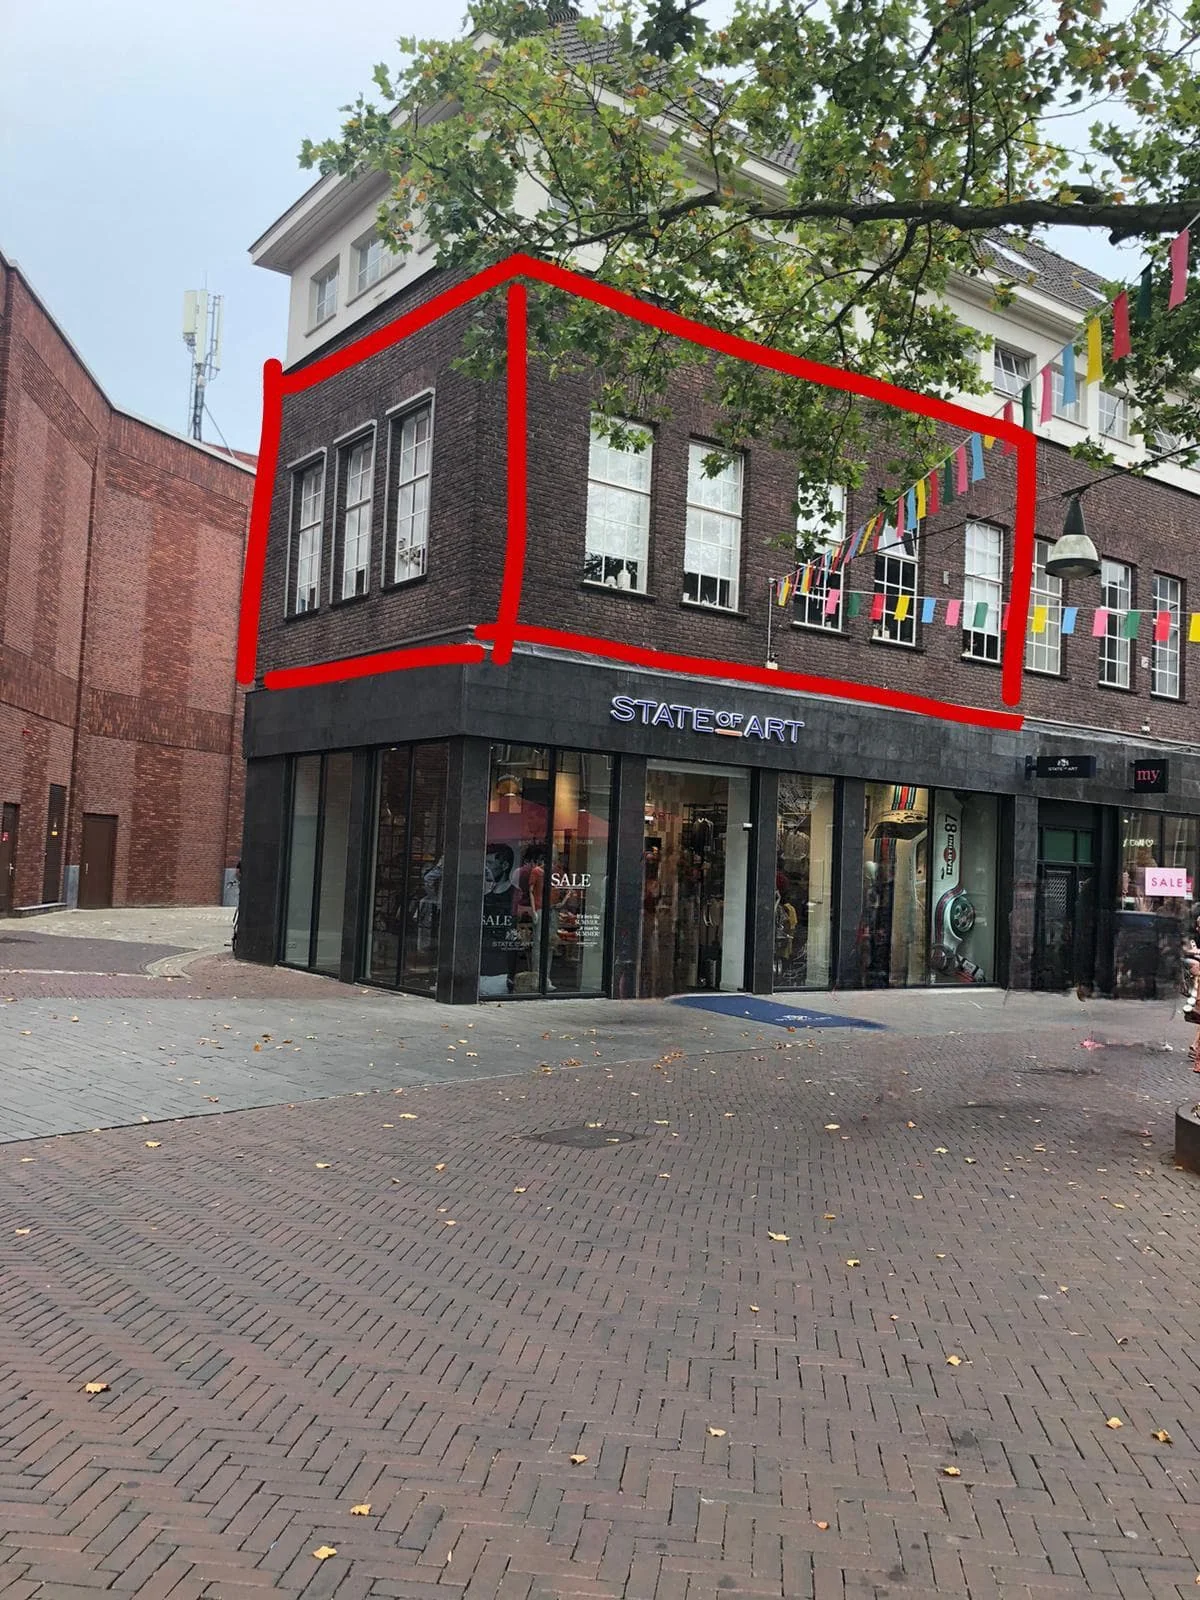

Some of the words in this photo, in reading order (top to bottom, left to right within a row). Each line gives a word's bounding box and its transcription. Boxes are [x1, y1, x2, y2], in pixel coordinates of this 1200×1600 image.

[610, 696, 714, 733] STATE
[715, 711, 744, 728] OF
[744, 715, 805, 744] ART
[1136, 769, 1160, 784] my
[944, 814, 958, 833] 87
[551, 873, 591, 888] SALE
[1151, 877, 1183, 888] SALE
